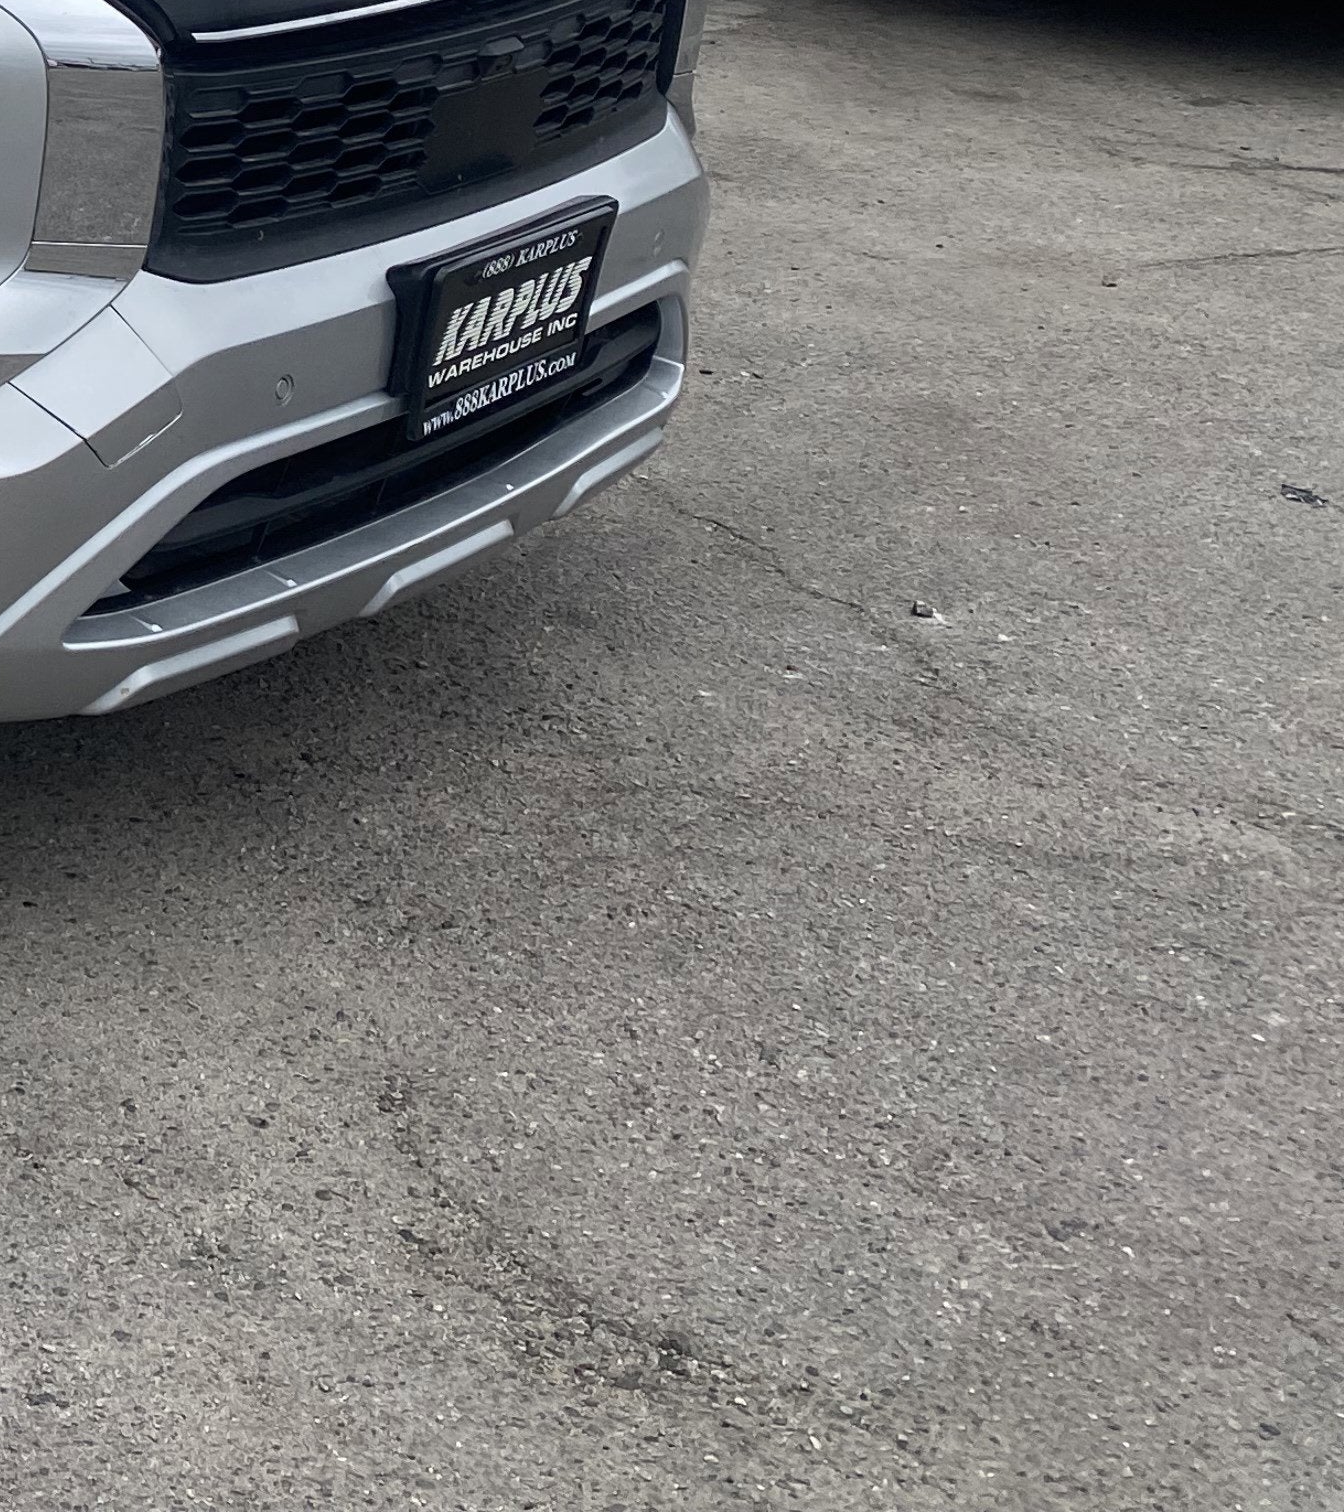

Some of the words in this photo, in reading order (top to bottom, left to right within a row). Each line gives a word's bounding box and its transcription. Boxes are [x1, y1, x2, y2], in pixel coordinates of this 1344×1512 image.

[428, 327, 543, 388] WAREHOUSE
[547, 313, 578, 337] INC
[432, 256, 593, 367] KARPLUS
